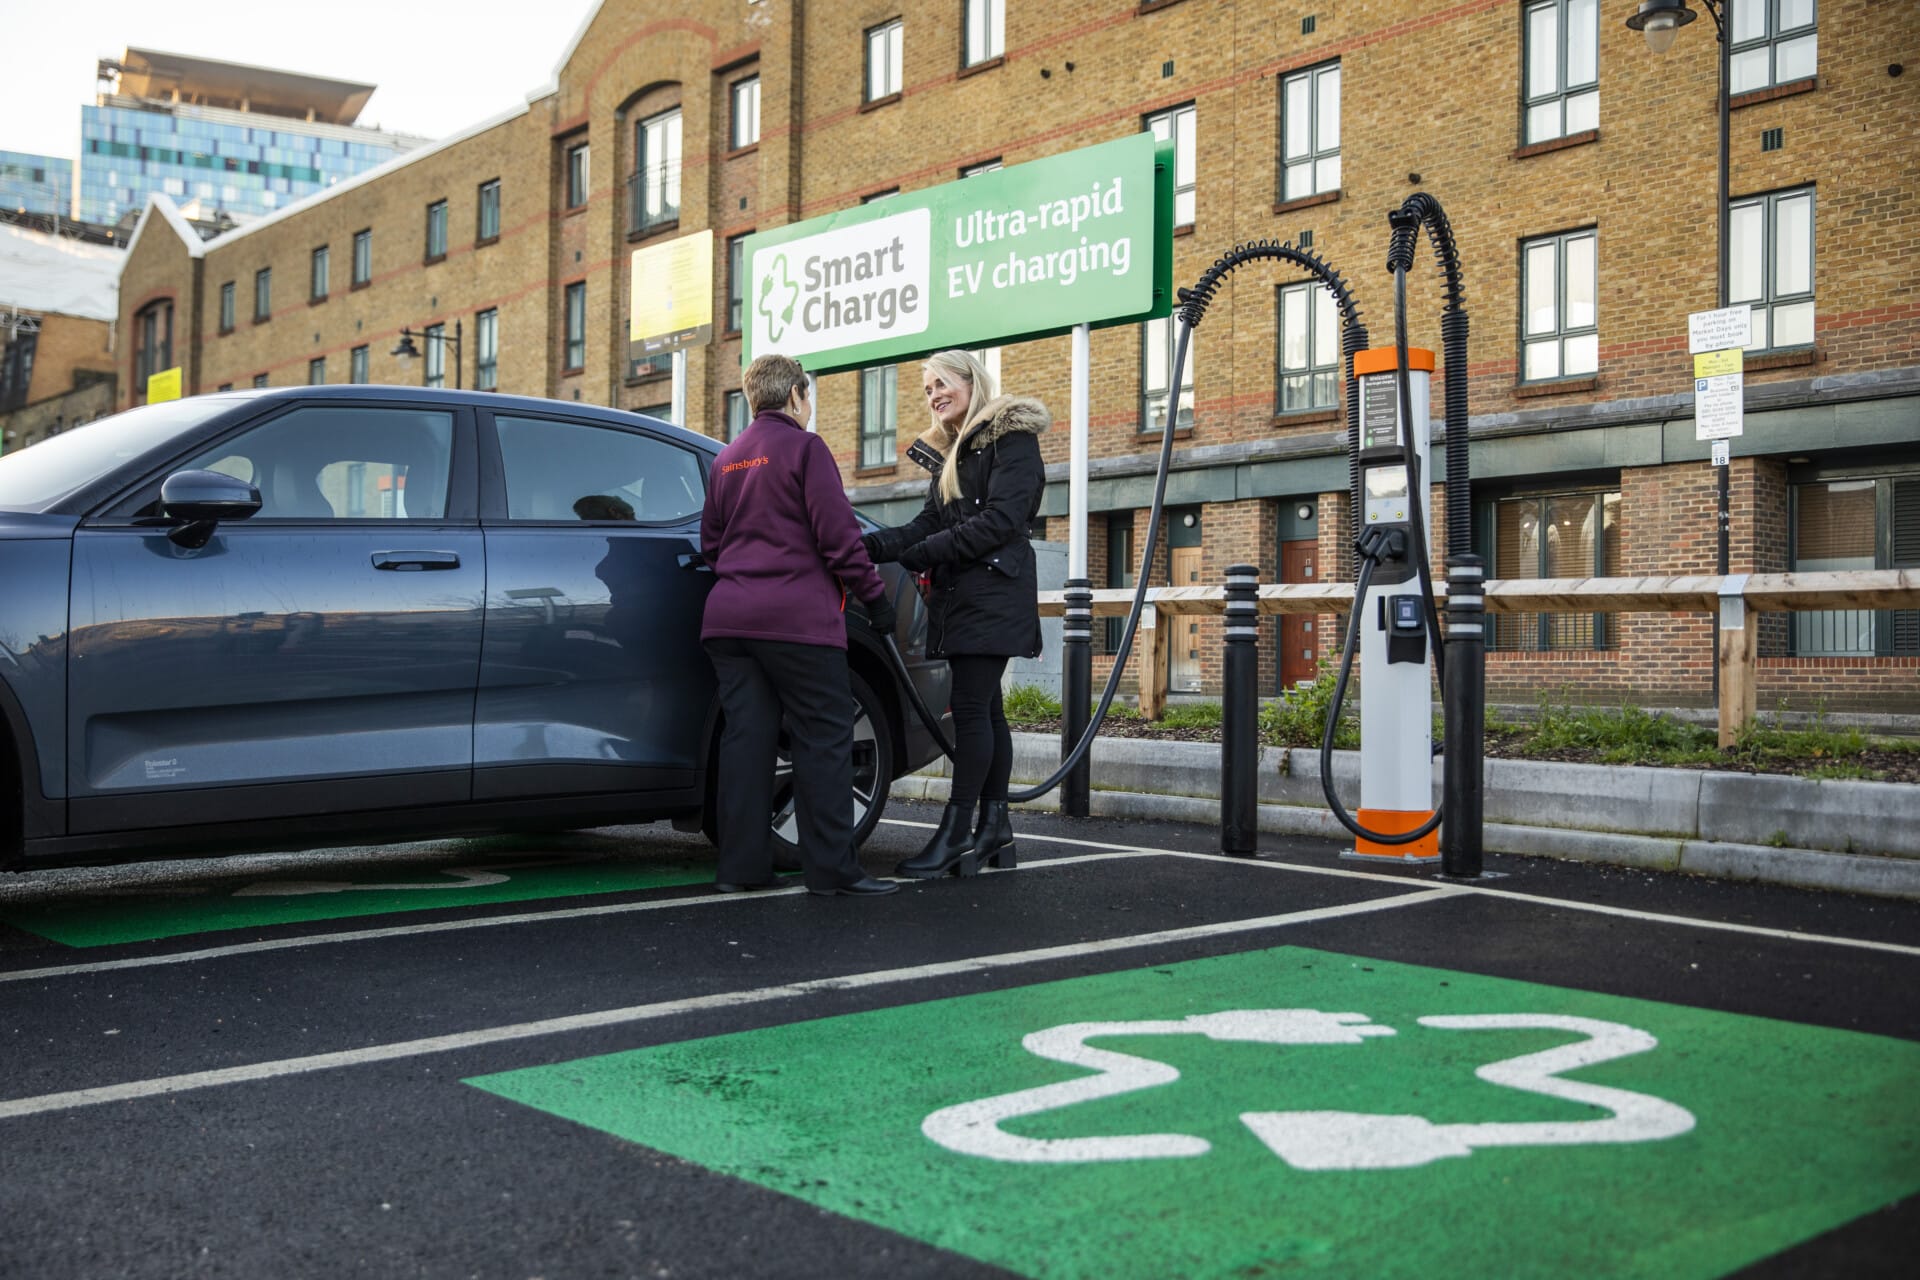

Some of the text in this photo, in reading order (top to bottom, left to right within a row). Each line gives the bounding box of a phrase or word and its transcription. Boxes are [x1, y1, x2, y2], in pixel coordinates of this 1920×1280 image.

[955, 176, 1124, 248] Ultra-rapid
[804, 236, 905, 292] Smart
[947, 236, 1131, 299] EV charging
[802, 284, 919, 333] Charge
[1715, 456, 1726, 465] 18
